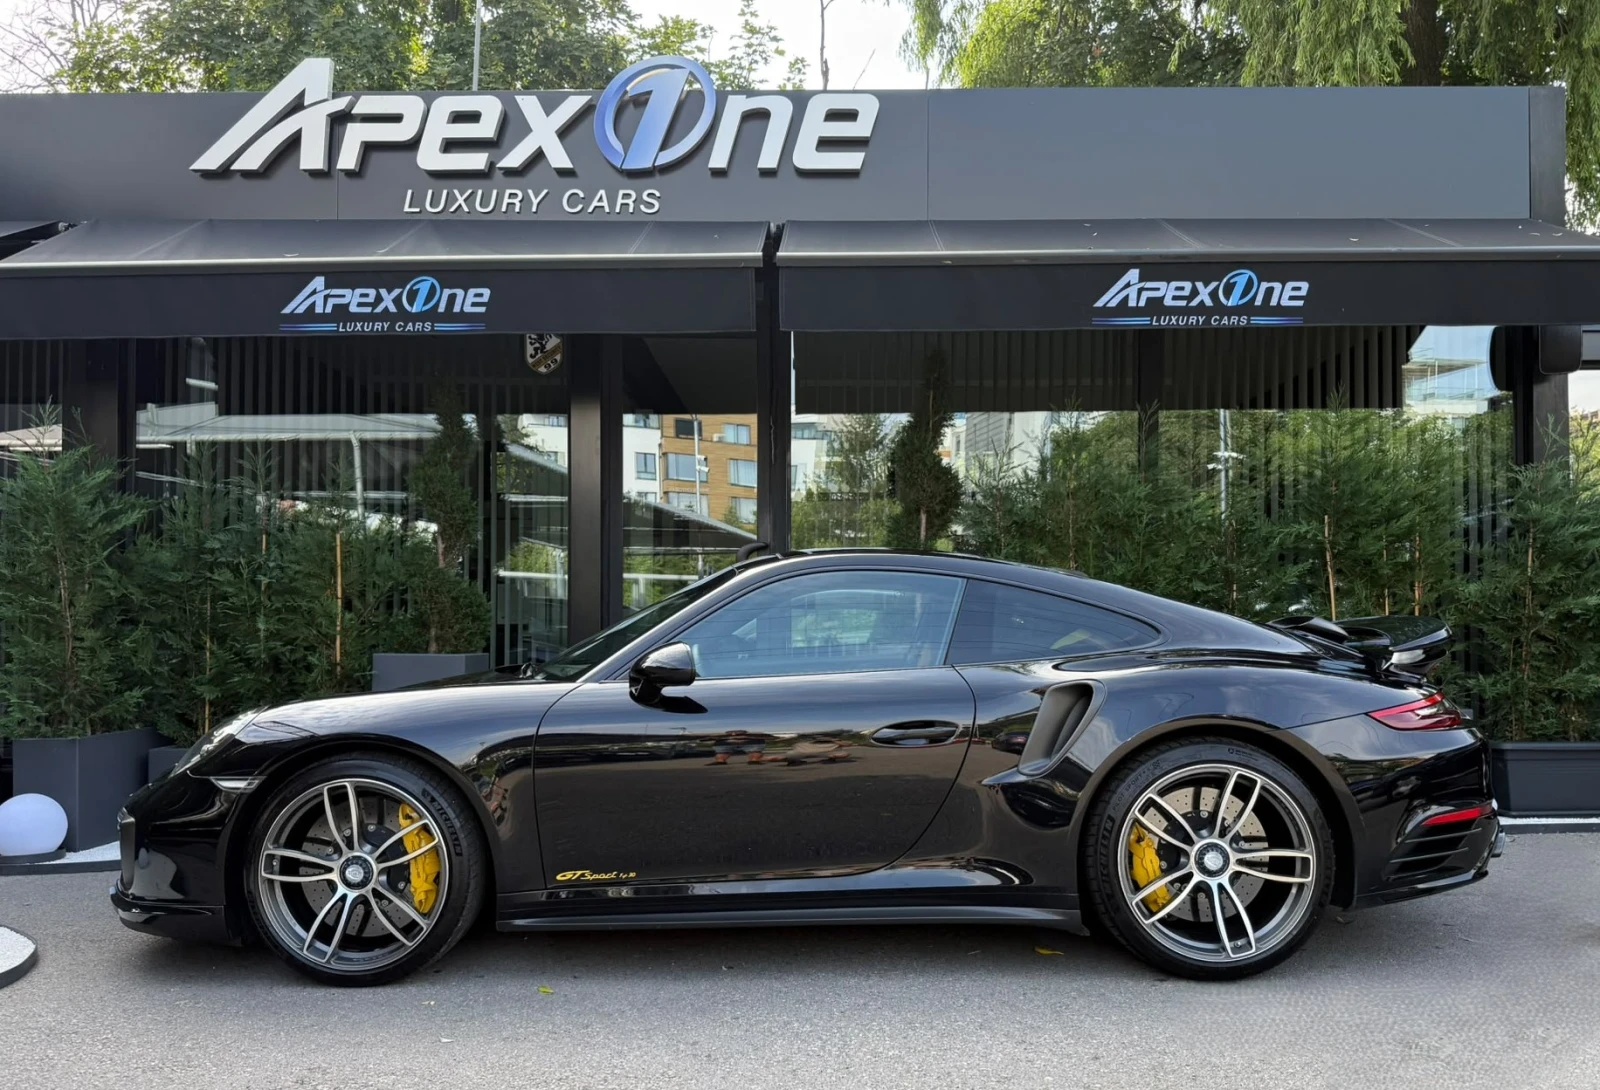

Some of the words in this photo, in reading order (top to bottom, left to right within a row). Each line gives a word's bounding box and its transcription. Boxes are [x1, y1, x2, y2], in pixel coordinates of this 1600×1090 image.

[403, 188, 548, 214] LUXURY
[562, 188, 662, 214] CARS
[1152, 315, 1206, 326] LUXURY
[1211, 315, 1249, 326] CARS
[338, 322, 391, 333] LUXURY
[395, 322, 433, 333] CARS
[555, 870, 590, 880] GT
